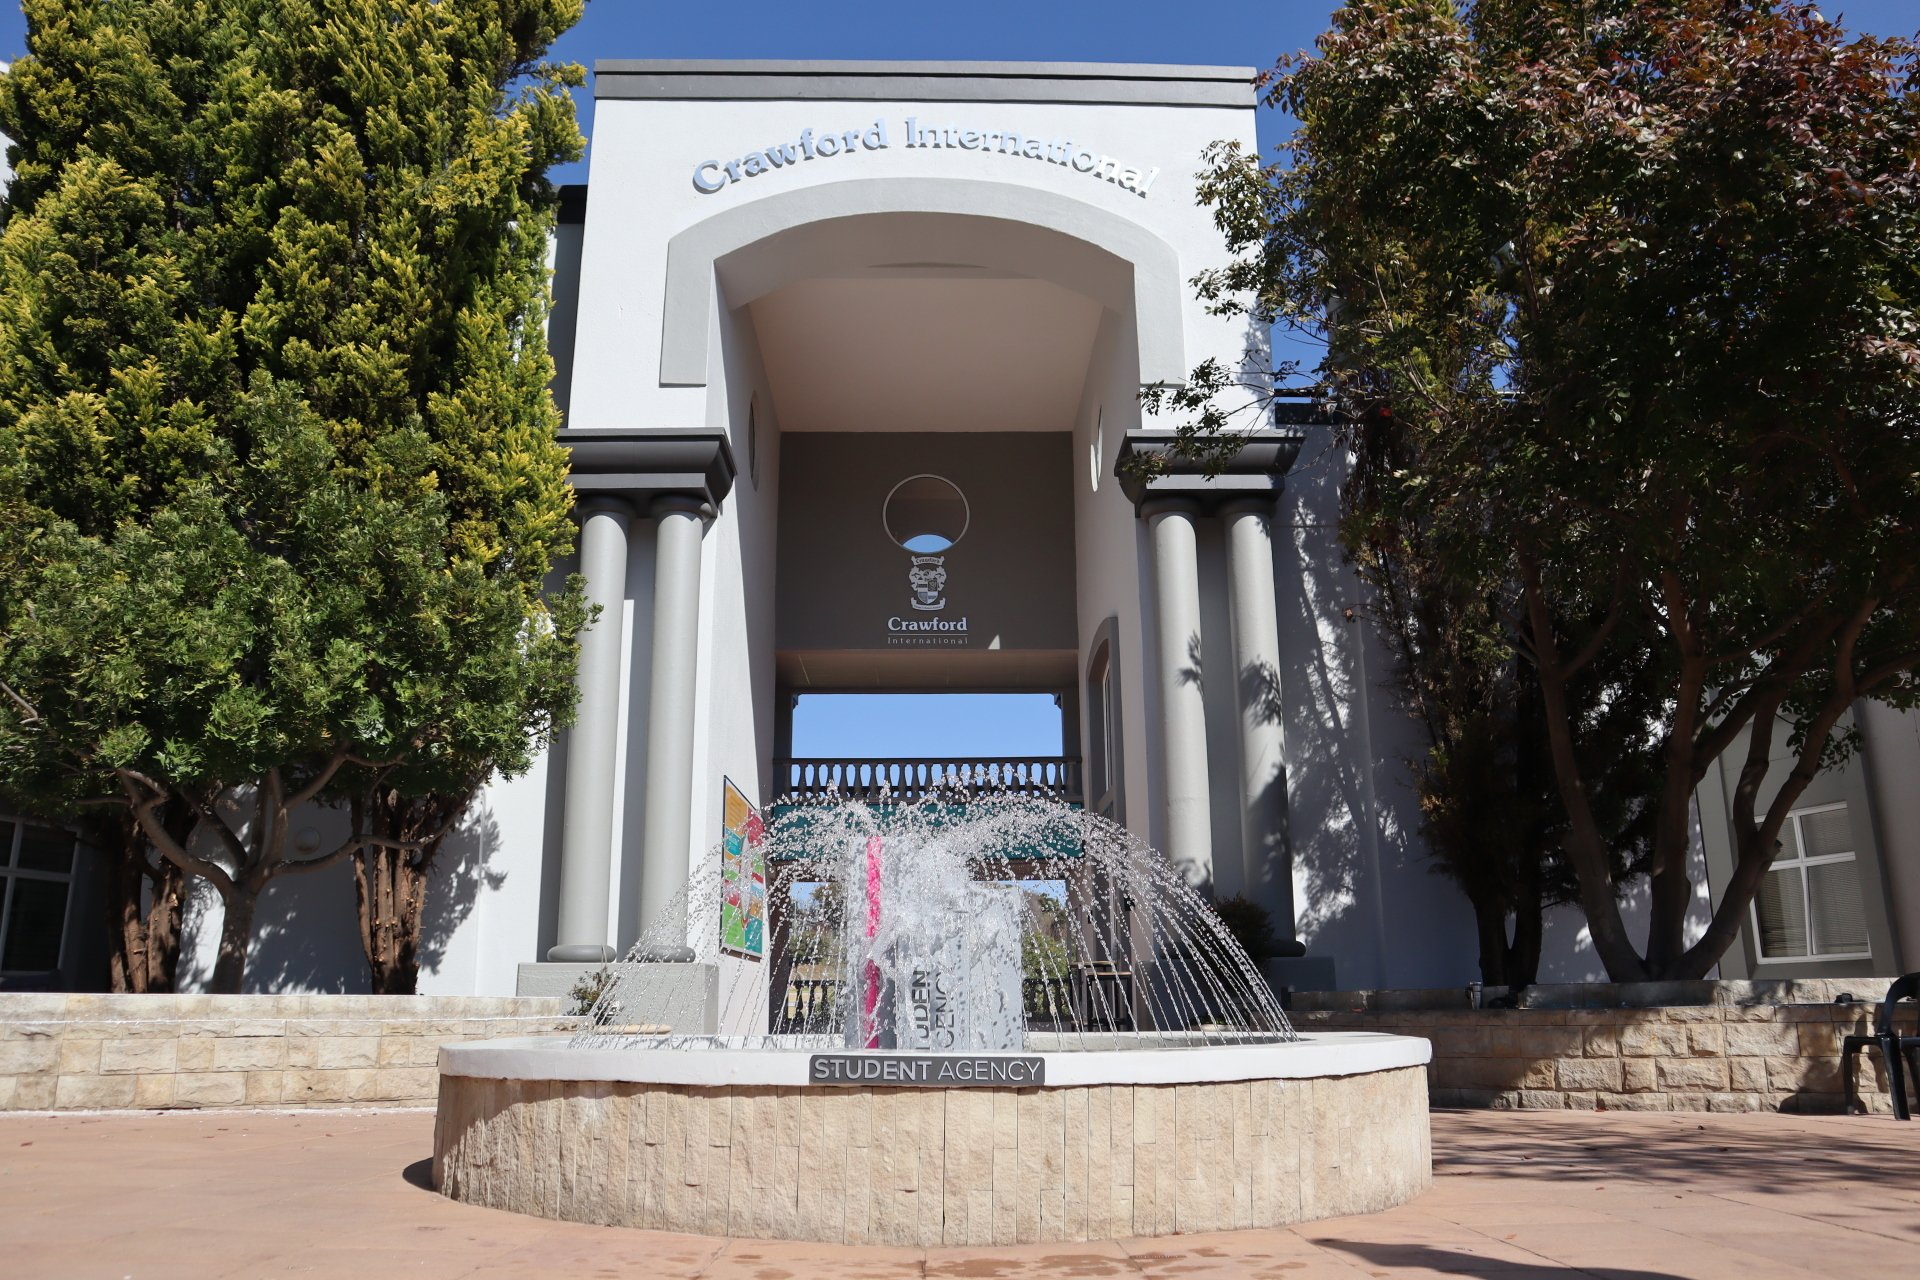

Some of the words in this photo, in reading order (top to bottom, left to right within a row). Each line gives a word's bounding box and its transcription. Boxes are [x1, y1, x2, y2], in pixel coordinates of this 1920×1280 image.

[692, 118, 891, 195] Crawford
[904, 116, 1161, 199] International
[887, 616, 968, 631] Crawford
[887, 636, 968, 645] International
[813, 1057, 933, 1081] STUDENT
[937, 1059, 1042, 1081] AGENCY
